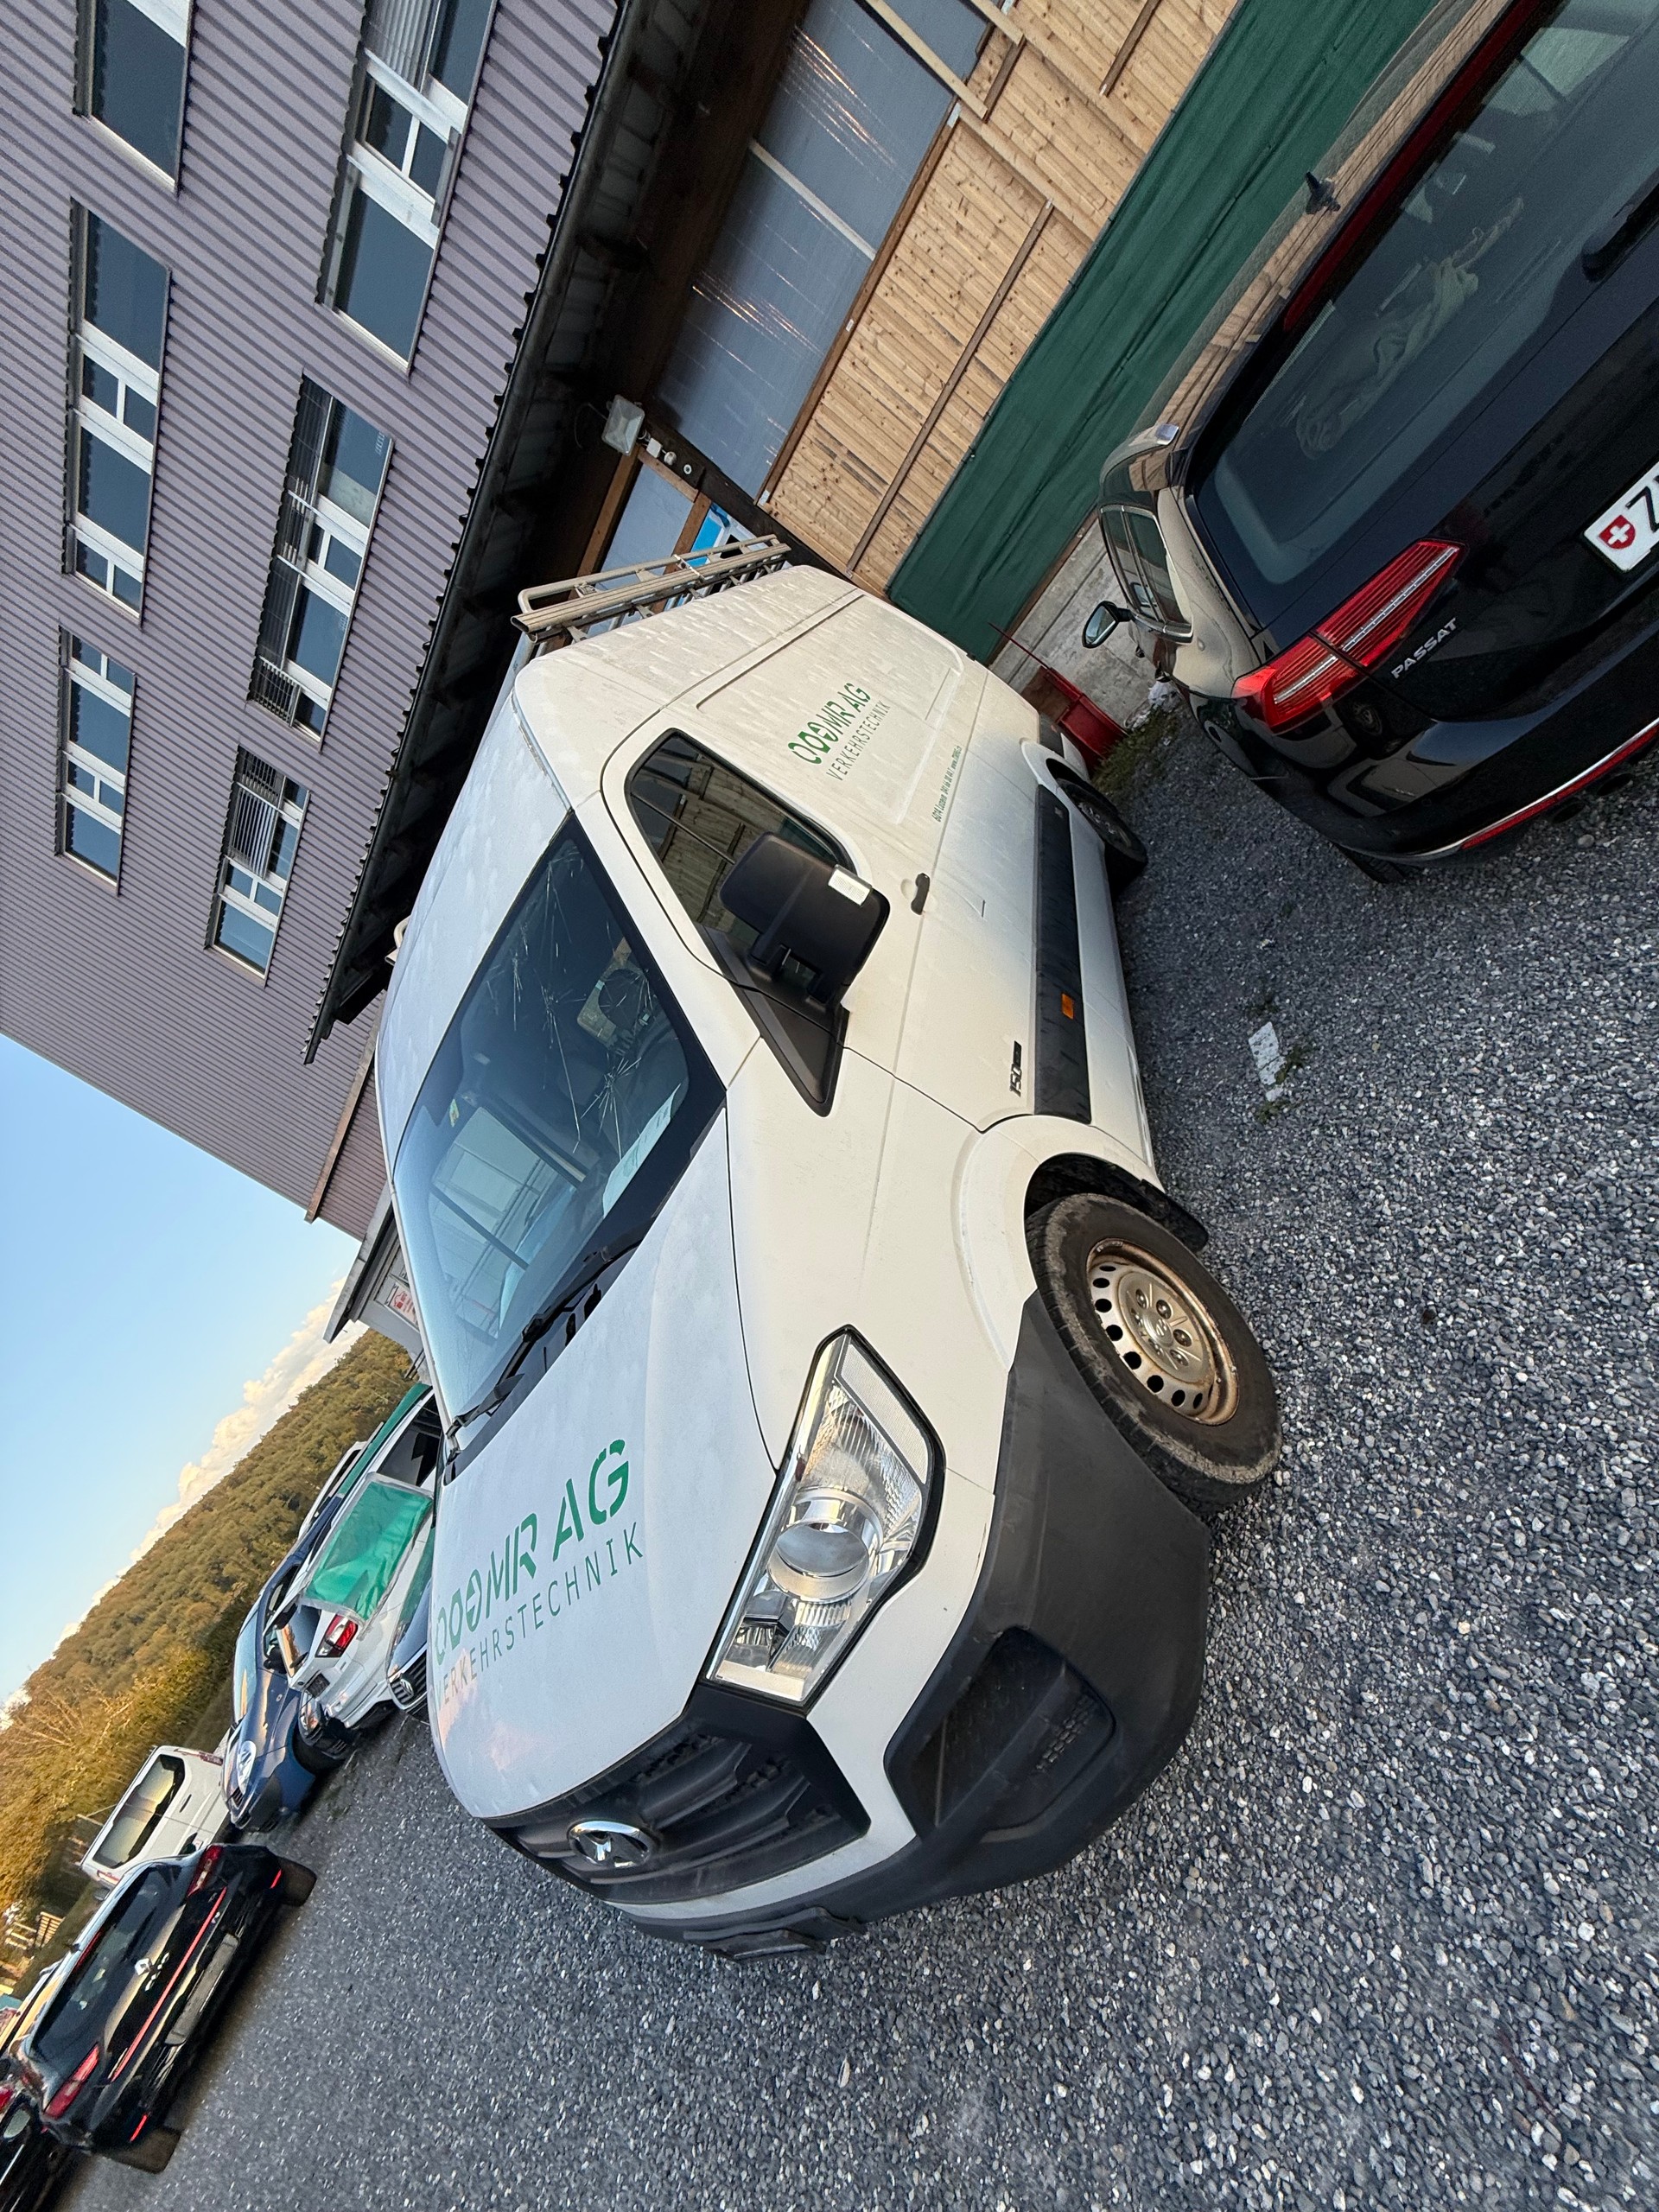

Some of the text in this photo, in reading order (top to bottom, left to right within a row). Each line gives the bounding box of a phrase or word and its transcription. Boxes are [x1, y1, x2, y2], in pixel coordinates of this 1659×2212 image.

[1625, 474, 1659, 533] Z
[1391, 617, 1459, 680] PASSAT
[837, 683, 871, 713] AG
[826, 700, 891, 781] VERKEHRSTECHNIK
[1009, 1064, 1022, 1097] 150
[553, 1439, 630, 1562] AG
[435, 1522, 644, 1711] VERKEHRSTECHNIK
